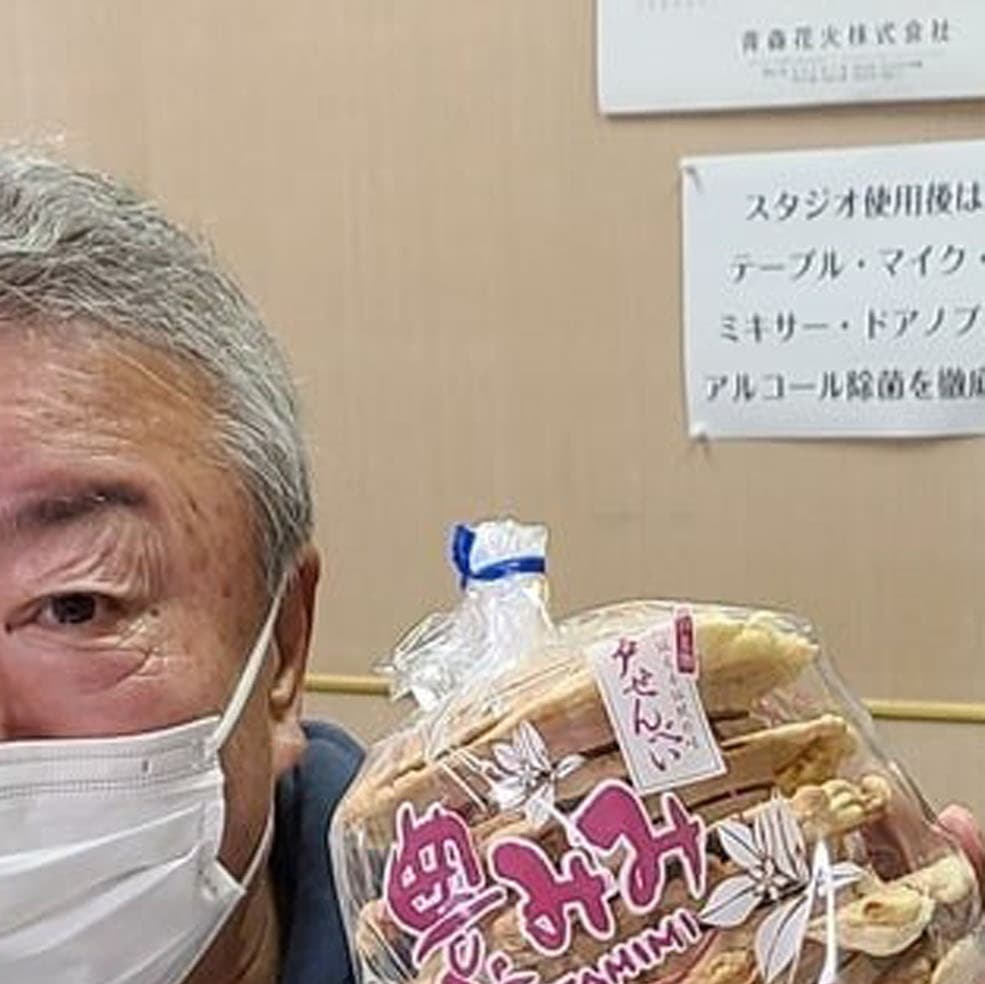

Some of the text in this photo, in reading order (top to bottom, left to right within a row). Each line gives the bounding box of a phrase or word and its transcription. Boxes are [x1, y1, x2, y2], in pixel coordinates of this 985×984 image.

[746, 181, 983, 220] スタジオ使用後は
